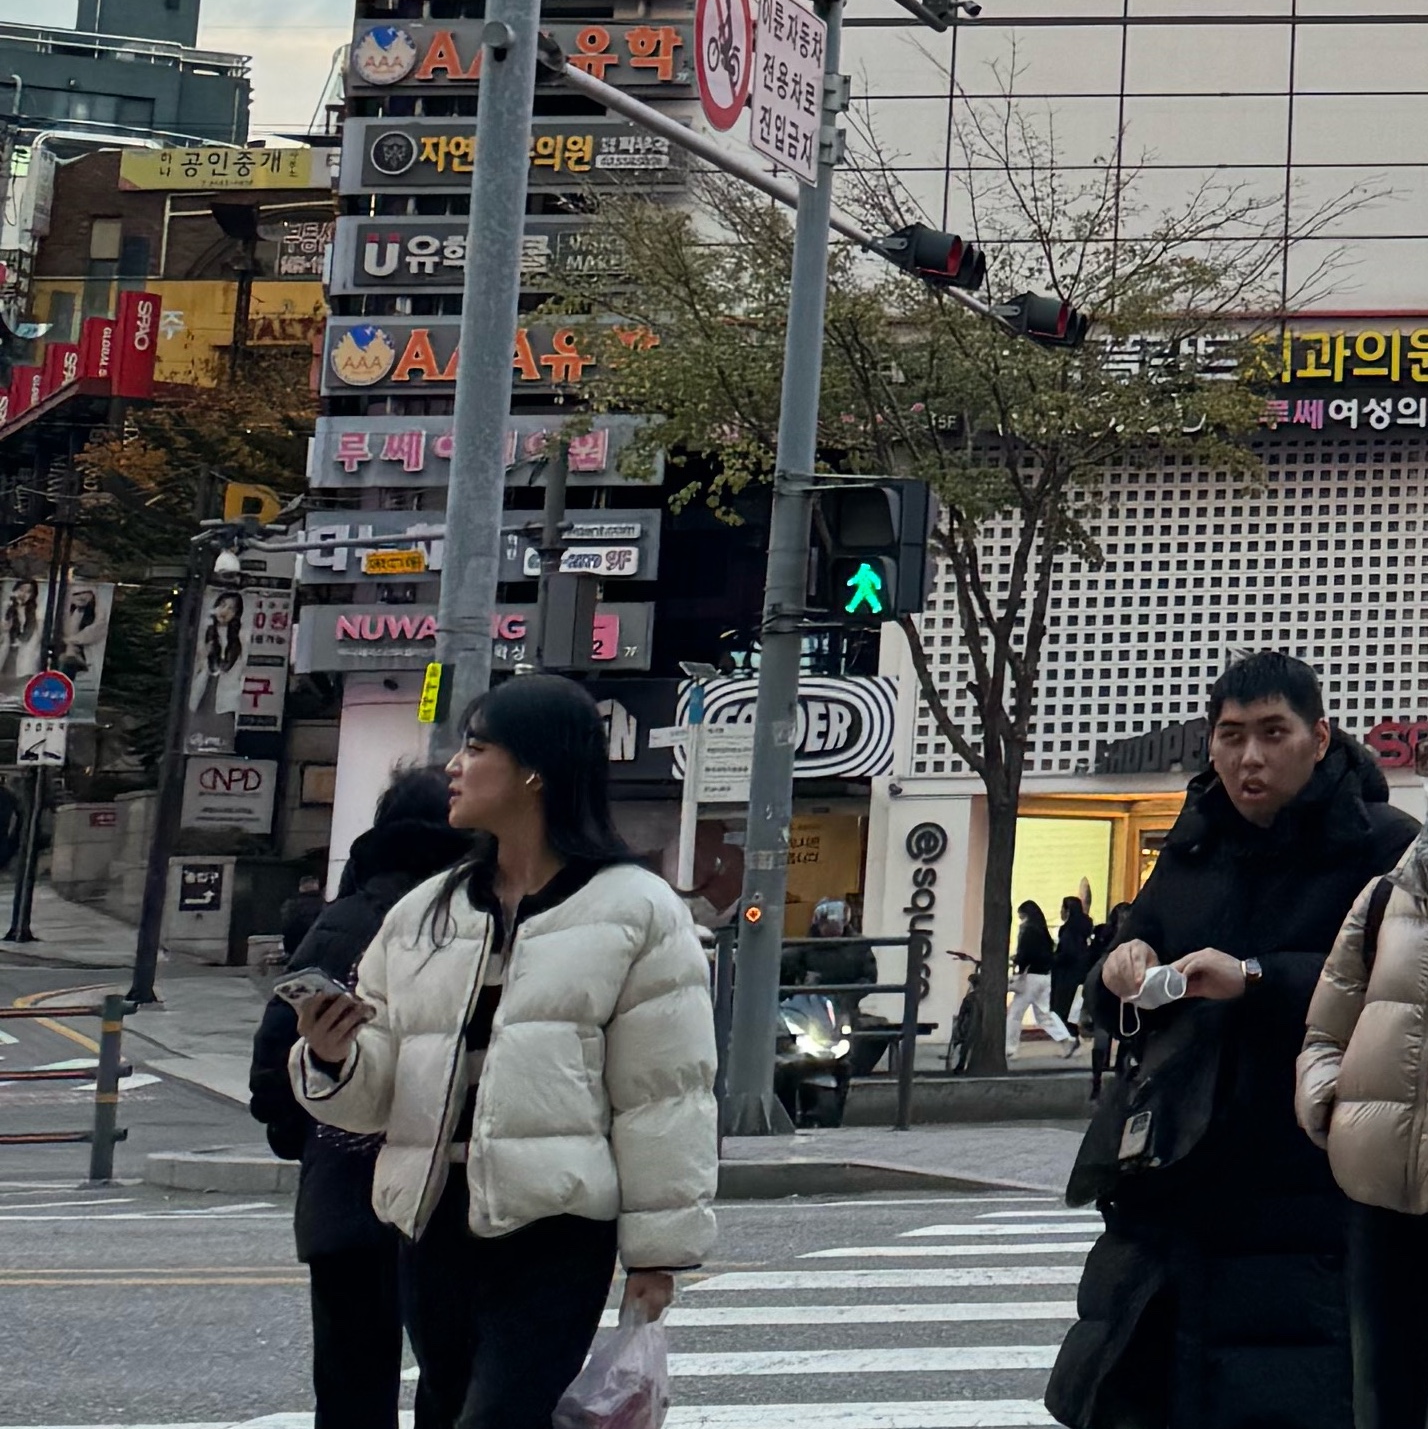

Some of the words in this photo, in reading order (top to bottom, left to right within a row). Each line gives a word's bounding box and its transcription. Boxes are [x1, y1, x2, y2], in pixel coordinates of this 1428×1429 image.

[763, 52, 816, 117] 전용차로
[759, 105, 814, 170] 진입금지
[180, 150, 282, 178] 공인중개
[342, 356, 383, 371] AAA
